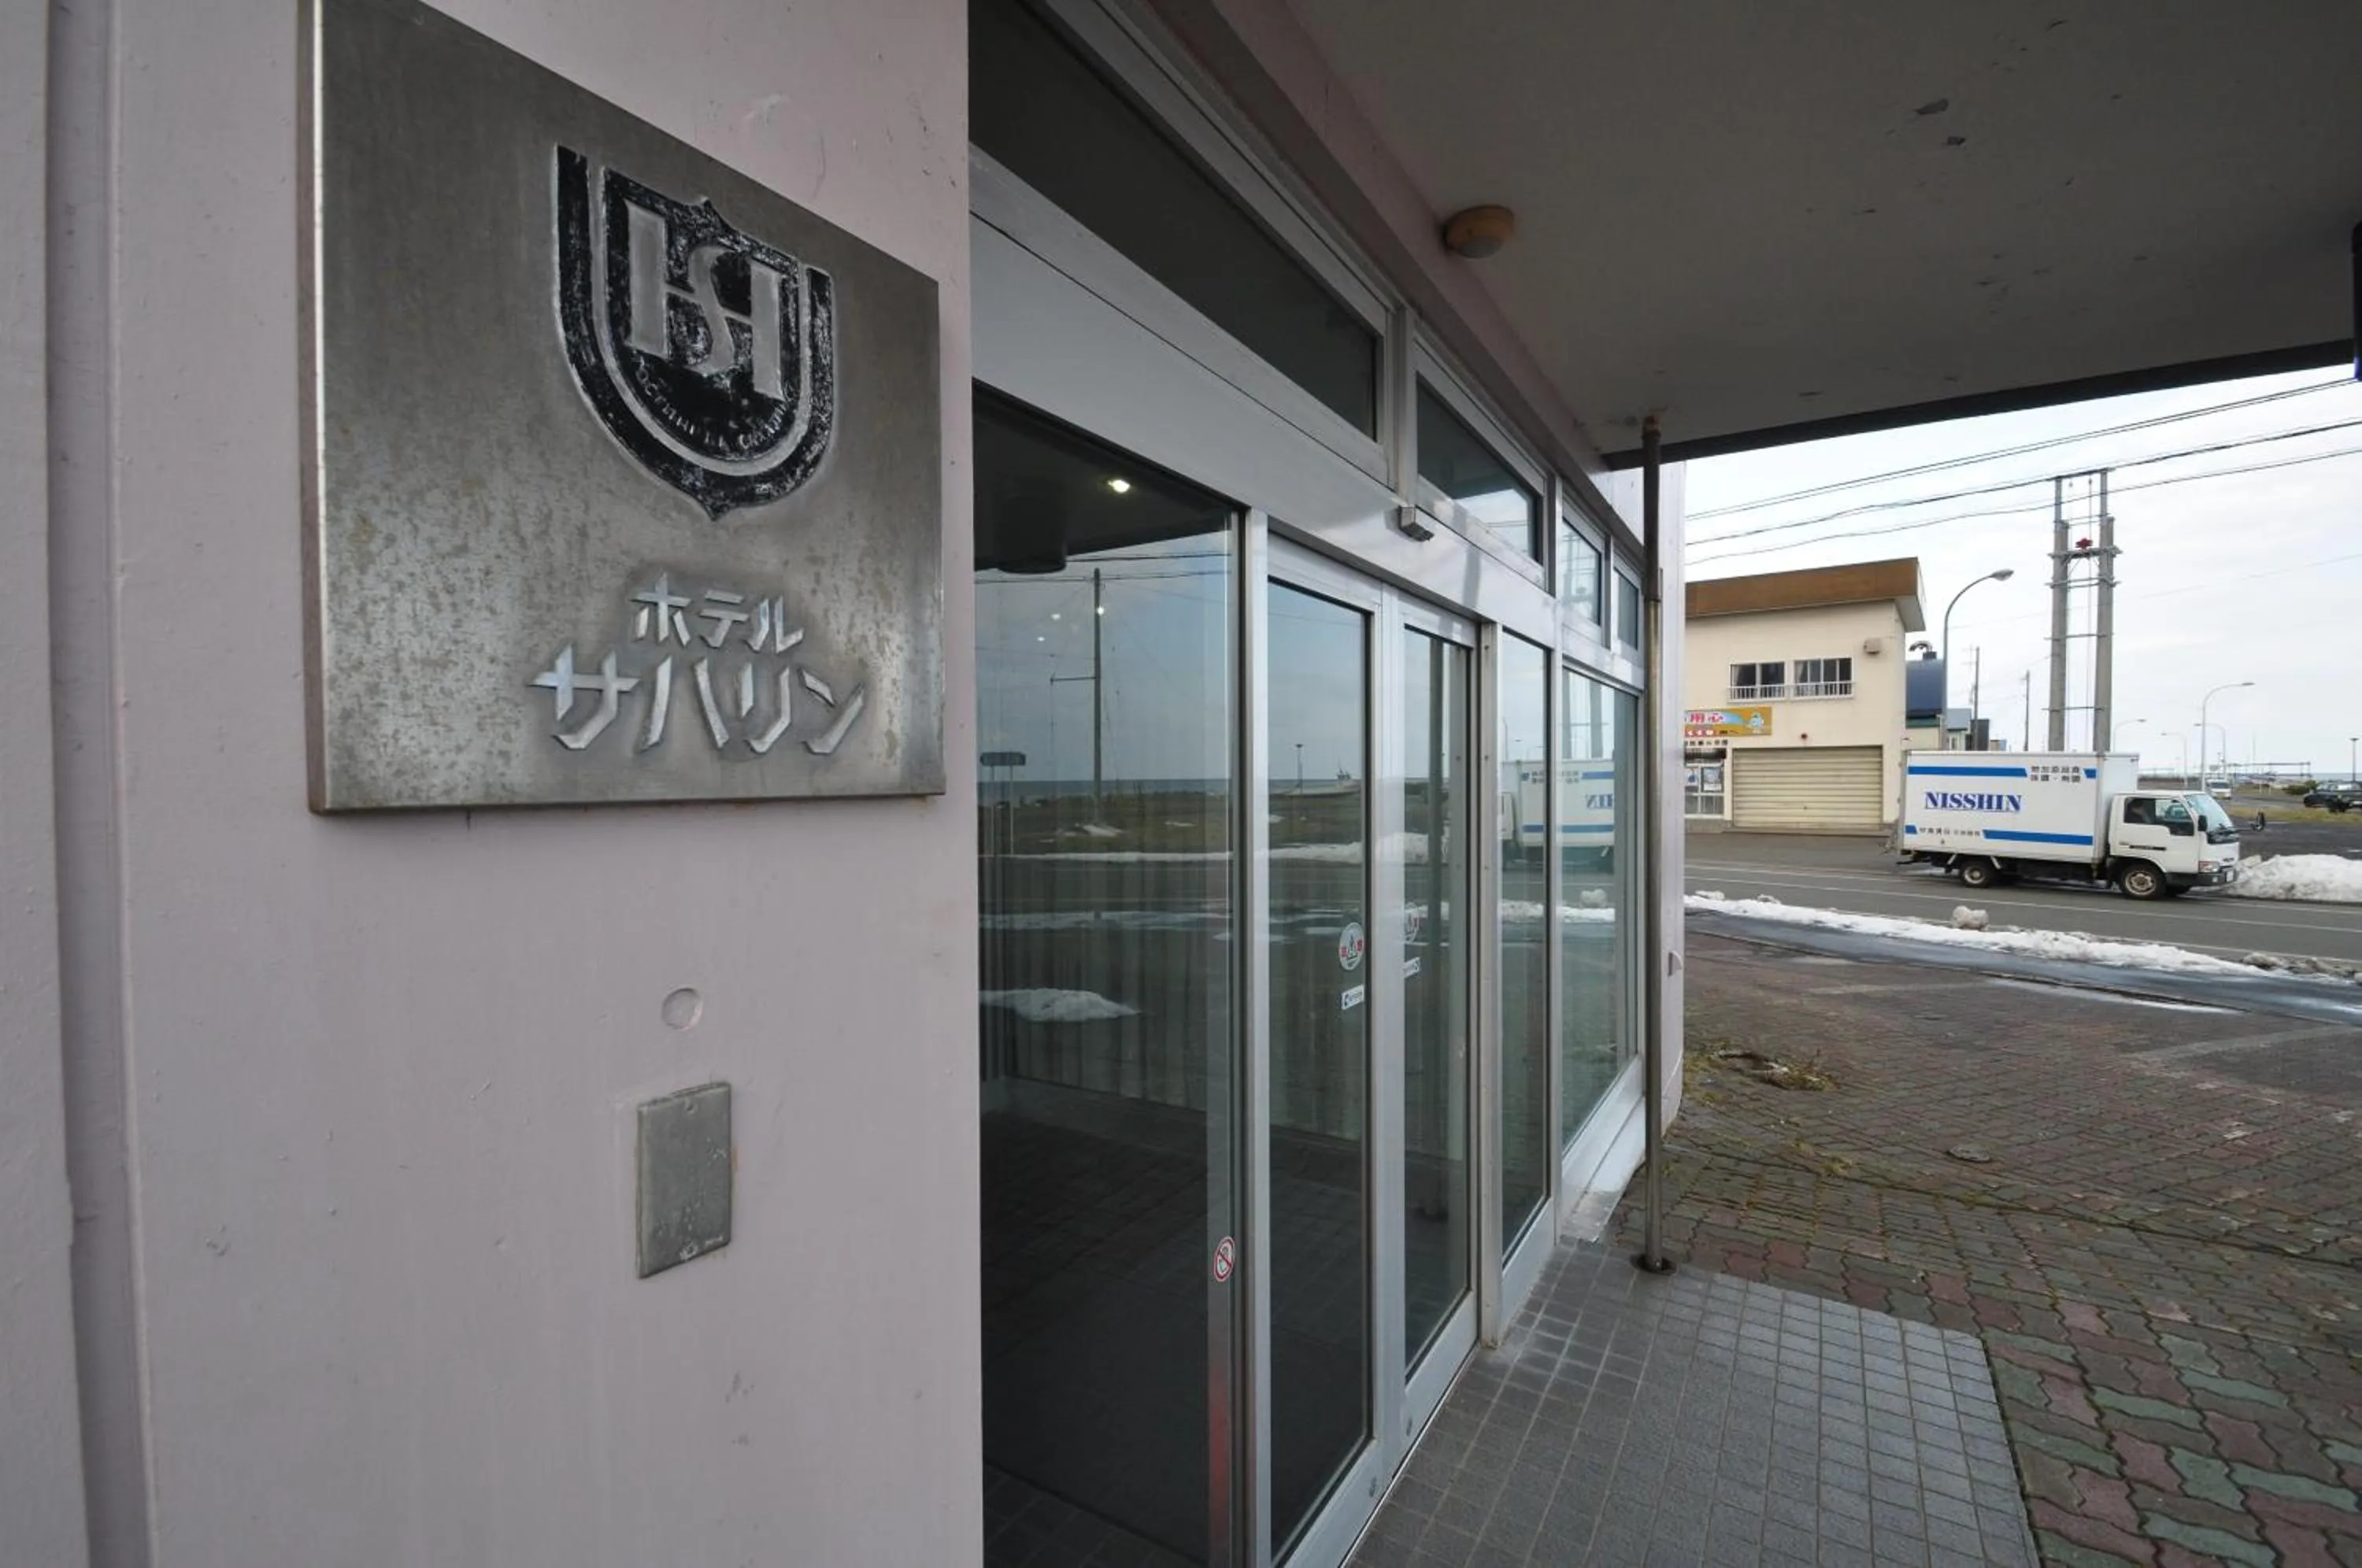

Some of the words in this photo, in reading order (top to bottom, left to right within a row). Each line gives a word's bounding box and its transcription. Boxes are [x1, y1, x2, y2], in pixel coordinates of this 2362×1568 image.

[631, 571, 805, 654] ホテル
[526, 643, 865, 755] サハリン
[1924, 790, 2022, 813] NISSHIN
